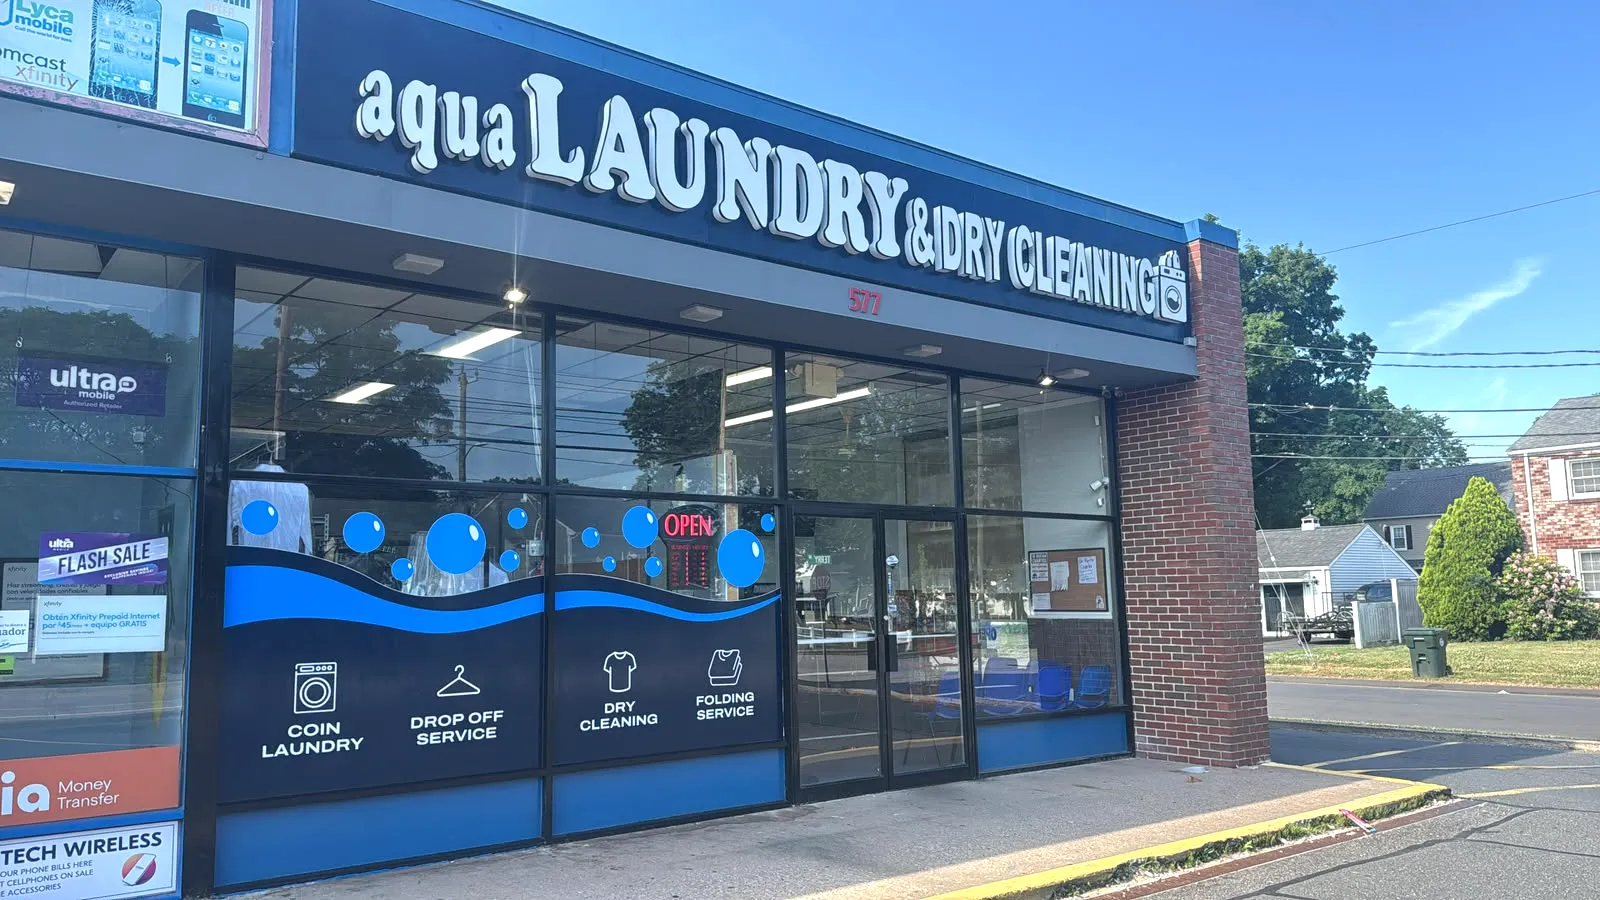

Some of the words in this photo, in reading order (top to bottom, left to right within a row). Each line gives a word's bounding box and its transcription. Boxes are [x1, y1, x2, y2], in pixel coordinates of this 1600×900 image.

[16, 0, 74, 24] Lyca
[15, 14, 73, 36] mobile
[0, 47, 66, 72] mcast
[16, 65, 79, 91] xfinity
[356, 69, 517, 175] aqua
[521, 72, 909, 259] LAUNDRY
[904, 197, 935, 269] &
[934, 205, 1005, 283] DRY
[1007, 224, 1156, 316] CLEANING
[848, 286, 883, 316] 577
[50, 365, 117, 393] ultra
[78, 390, 116, 401] mobile
[664, 513, 713, 537] OPEN
[48, 538, 74, 549] ultra
[58, 549, 108, 575] FLASH
[113, 542, 151, 565] SALE
[42, 622, 57, 631] por
[91, 620, 118, 629] equipo
[119, 620, 148, 628] GRATIS
[70, 612, 98, 622] Xfinity
[99, 612, 129, 622] Prepaid
[130, 612, 161, 620] Internet
[604, 700, 636, 714] DRY
[696, 691, 755, 707] FOLDING
[410, 712, 465, 730] DROP
[468, 709, 505, 725] OFF
[579, 713, 659, 732] CLEANING
[696, 705, 755, 721] SERVICE
[287, 721, 341, 738] COIN
[416, 726, 498, 746] SERVICE
[261, 737, 364, 759] LAUNDRY
[58, 779, 112, 794] Money
[57, 792, 120, 810] Transfer
[0, 844, 57, 866] TECH
[63, 831, 163, 858] WIRELESS
[20, 865, 49, 876] PHONE
[51, 861, 72, 871] BILLS
[73, 859, 94, 868] HERE
[6, 872, 59, 888] CELLPHONES
[60, 870, 74, 880] ON
[75, 868, 94, 878] SALE
[7, 882, 62, 898] ACCESSORIES
